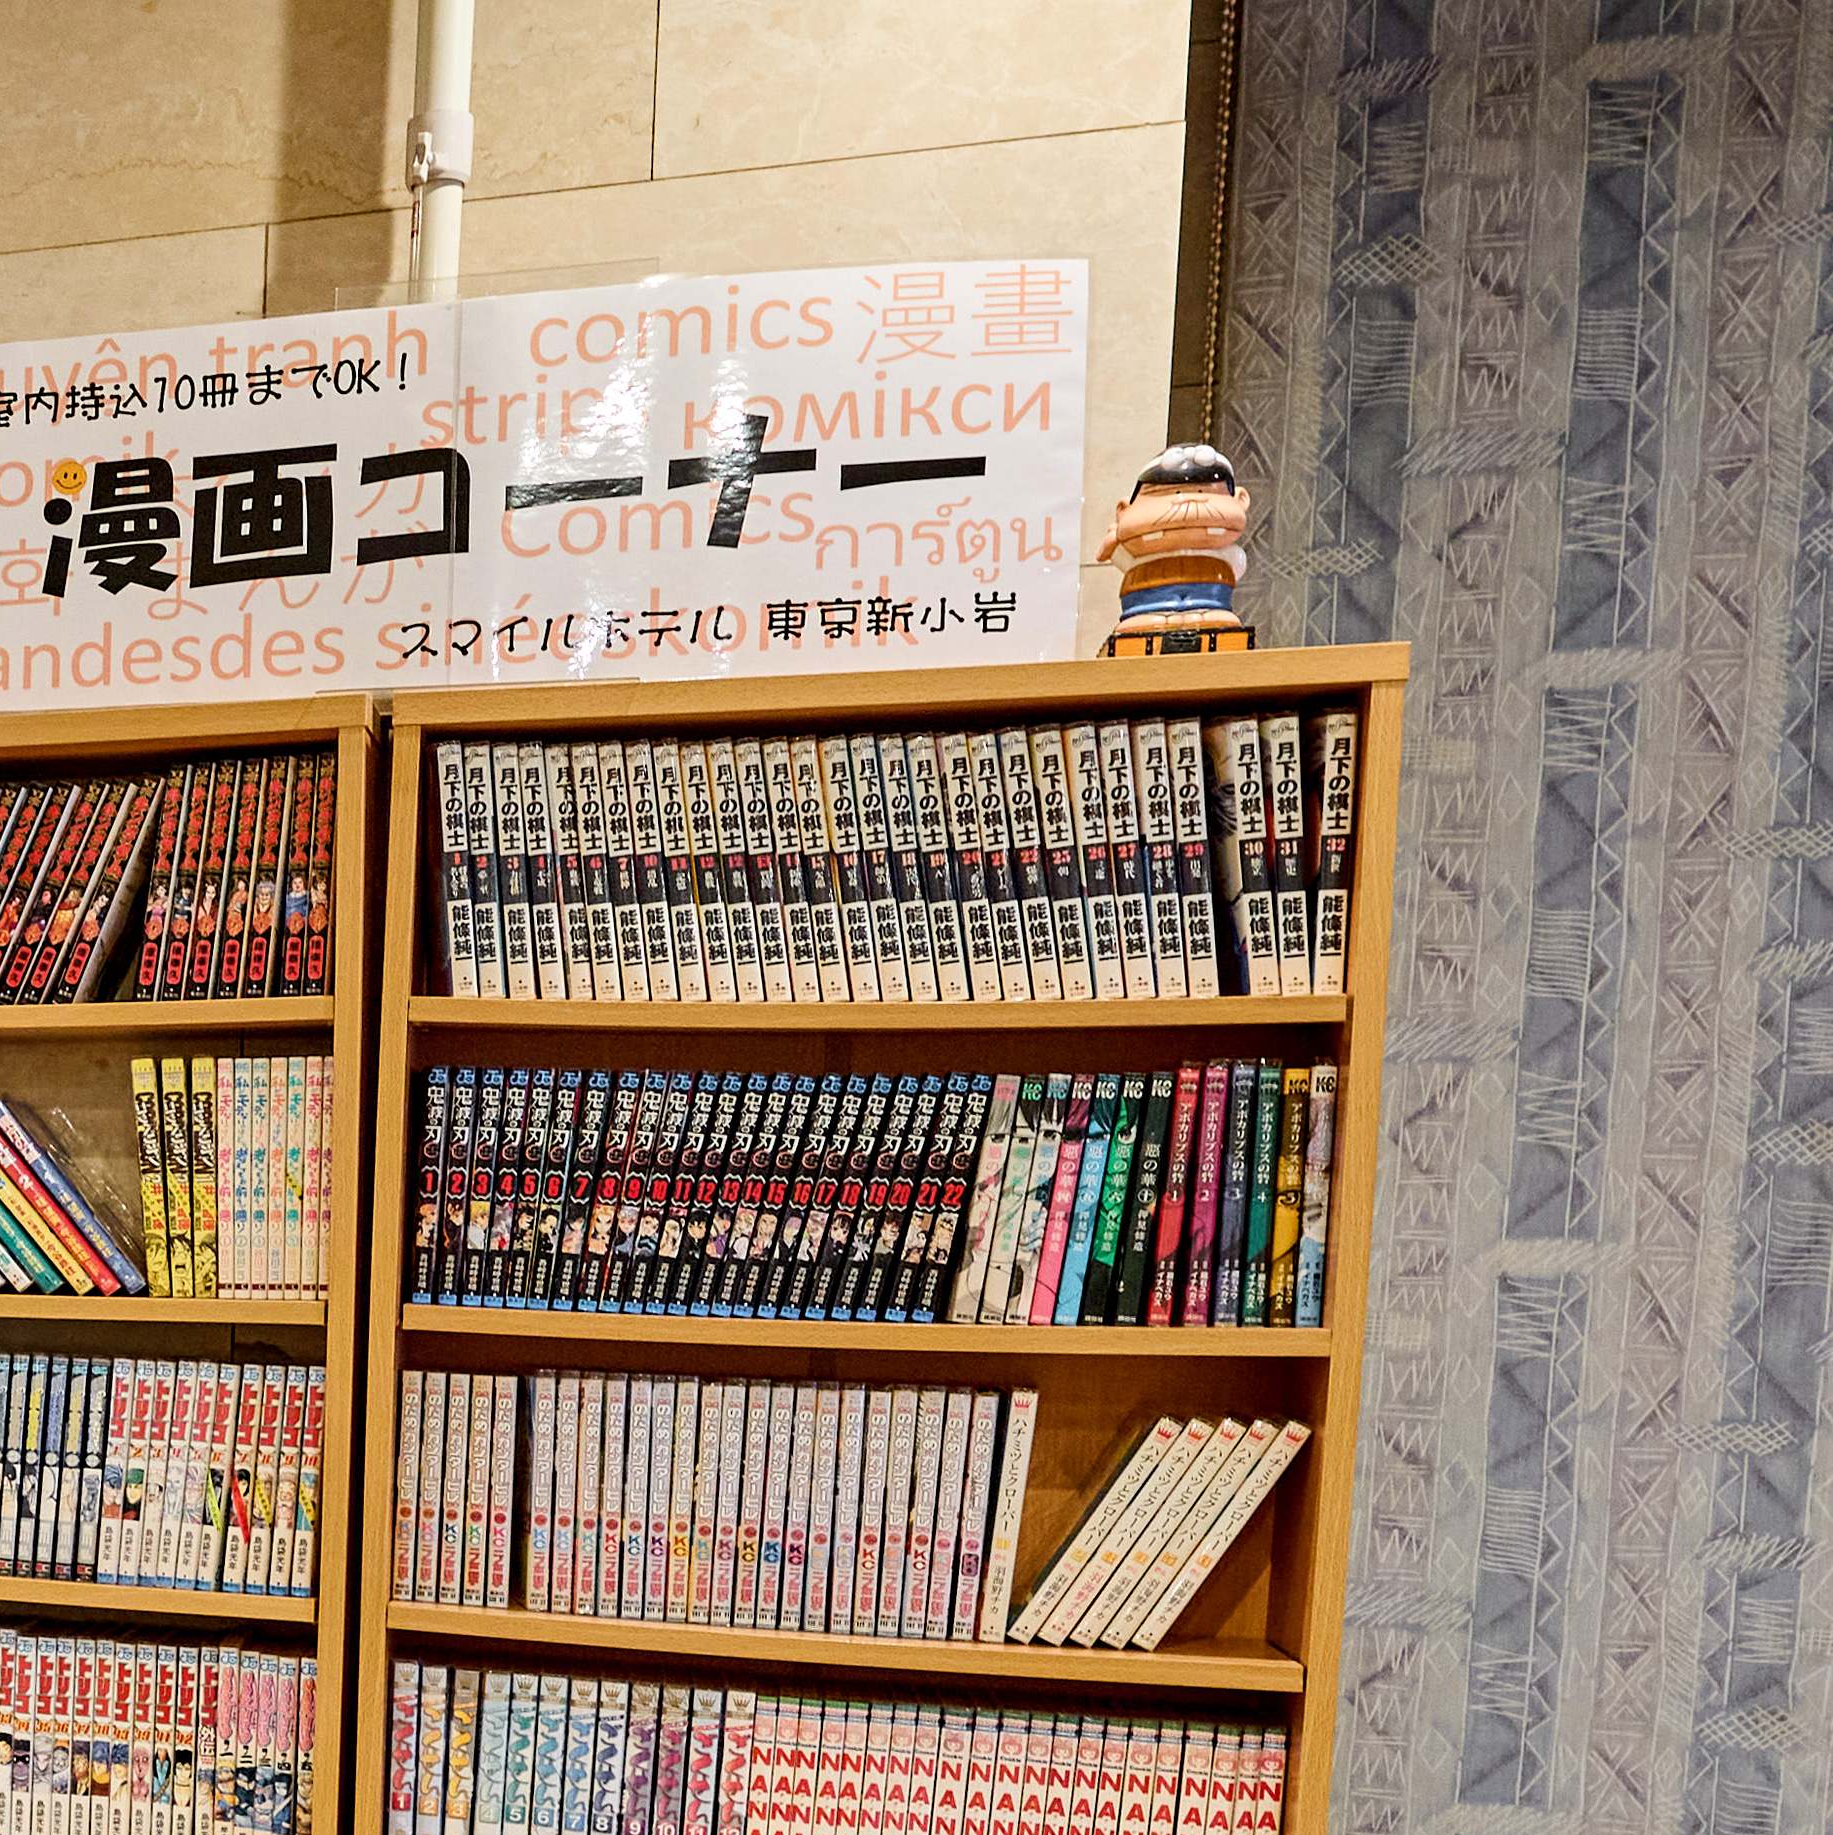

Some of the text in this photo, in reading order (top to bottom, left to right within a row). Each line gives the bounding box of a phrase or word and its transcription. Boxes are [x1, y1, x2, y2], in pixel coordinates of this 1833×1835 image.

[208, 310, 429, 400] tranh
[530, 284, 834, 368] comics
[856, 264, 1073, 363] 漫畫
[42, 414, 987, 599] 漫画コーナー
[500, 482, 816, 558] Comcs
[401, 590, 1017, 659] スマイルホテル 東京新小岩
[444, 764, 467, 848] 月下の棋士
[1108, 748, 1137, 858] 月下の棋士 27
[1177, 746, 1205, 858] 月下の棋士 29
[1237, 742, 1264, 856] 月下の棋士 30
[1275, 741, 1301, 855] 月下の棋士 31
[1326, 737, 1352, 831] 月下の棋士
[1326, 838, 1346, 852] 32
[423, 1085, 446, 1192] 鬼滅の刃 1
[450, 1086, 473, 1192] 鬼滅の刃 2
[476, 1173, 489, 1192] 3
[523, 1174, 536, 1193] 5
[574, 1089, 605, 1196] 鬼滅の刃 7
[805, 1092, 836, 1206] 鬼滅の刃 17
[941, 1093, 986, 1207] 鬼滅の刃 22
[547, 1176, 561, 1195] 6
[651, 1179, 668, 1198] 10
[891, 1184, 912, 1206] 20
[1002, 1418, 1031, 1532] ハチミツとクローバー
[175, 1665, 194, 1727] トリコ
[595, 1817, 610, 1832] 8
[628, 1821, 642, 1835] 9
